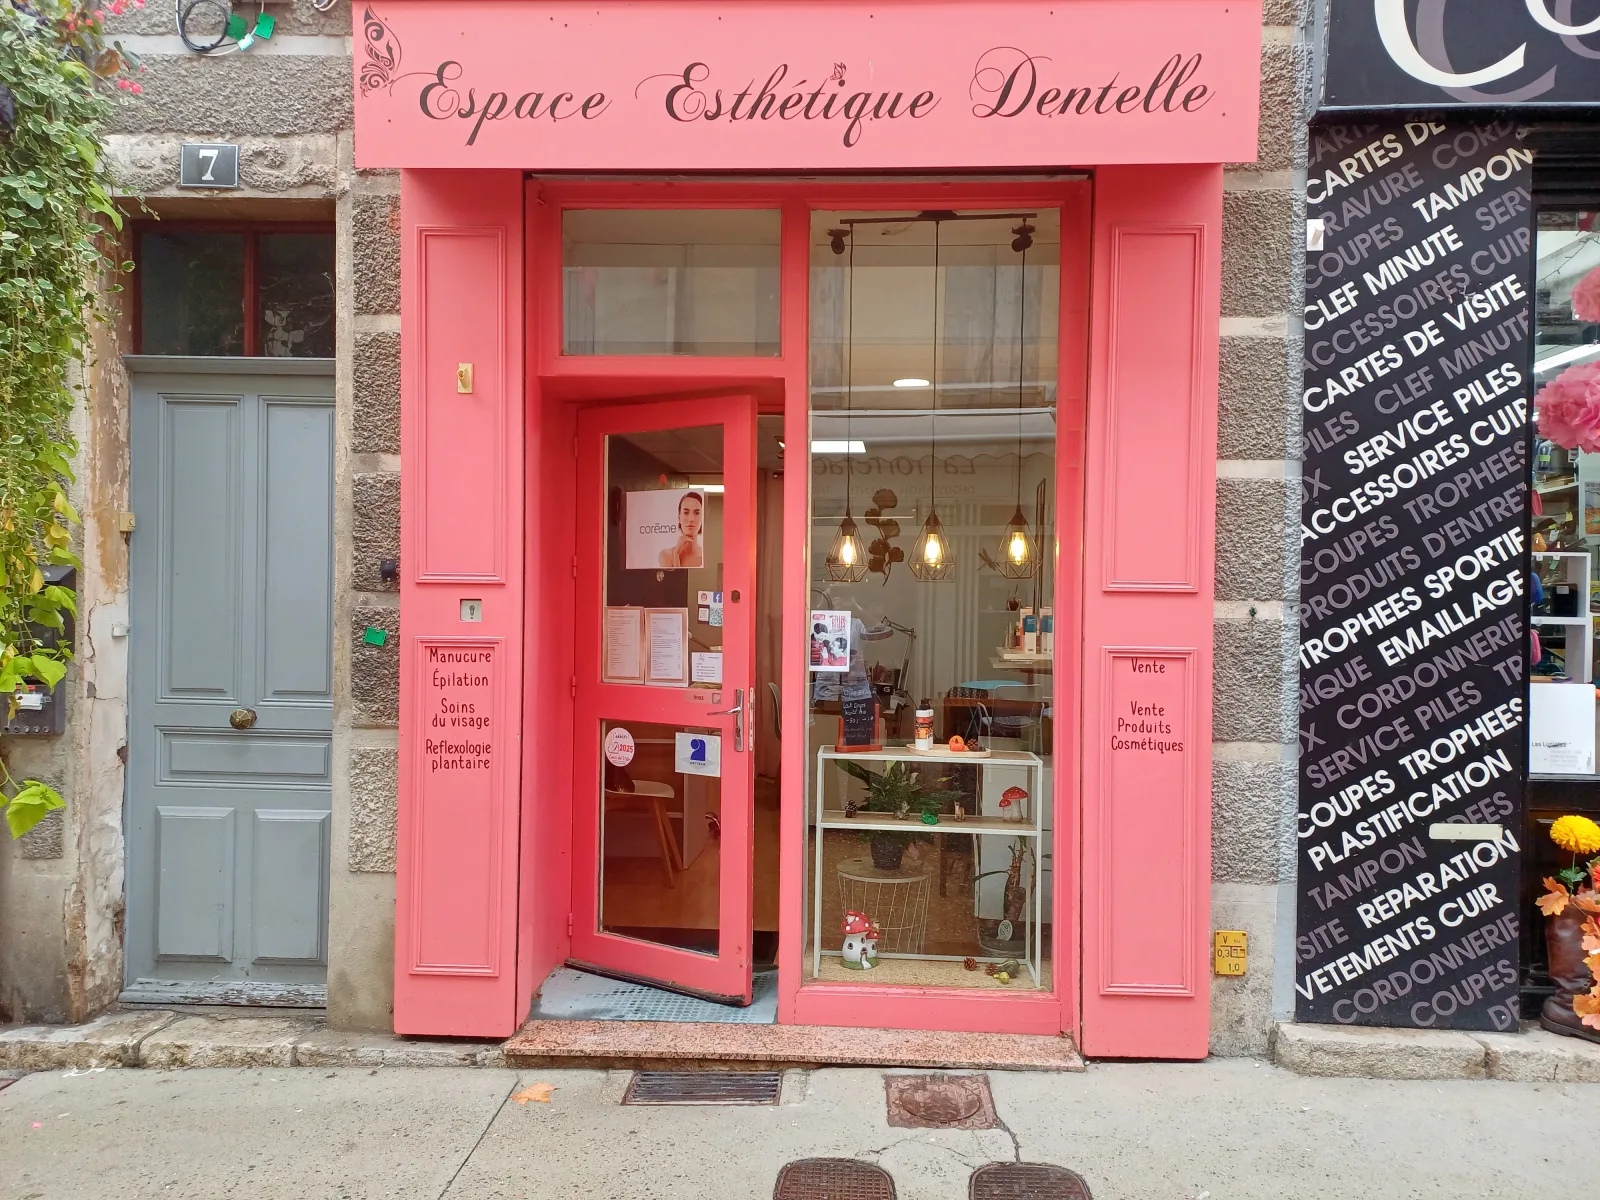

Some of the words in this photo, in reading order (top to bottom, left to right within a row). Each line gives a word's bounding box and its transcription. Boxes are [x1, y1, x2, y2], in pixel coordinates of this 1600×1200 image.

[390, 60, 612, 147] Espace
[635, 62, 941, 148] Esthétique
[970, 45, 1216, 119] Dentelle
[198, 148, 219, 182] 7
[1306, 133, 1404, 204] CARTES
[1319, 162, 1424, 237] RAVURE
[1305, 217, 1404, 289] COUPES
[1412, 147, 1534, 224] TAMPON
[1471, 226, 1530, 275] CUIR
[1303, 281, 1360, 331] CLEF
[1363, 225, 1464, 296] MINUTE
[1302, 344, 1403, 413] CARTES
[1403, 320, 1445, 357] DE
[1442, 272, 1527, 331] VISITE
[1343, 399, 1454, 475] SERVICE
[1452, 362, 1522, 414] PILES
[1374, 366, 1435, 414] CLEF
[1300, 434, 1470, 548] ACCESSOIRES
[1470, 397, 1527, 446] CUIR
[1300, 546, 1421, 629] PRODUITS
[1301, 515, 1400, 585] COUPES
[1299, 586, 1423, 670] TROPHEES
[1423, 526, 1525, 599] SPORTIF
[429, 647, 492, 663] Manucure
[432, 668, 489, 690] Épilation
[1131, 658, 1166, 674] Vente
[1299, 655, 1373, 714] RIQUE
[1377, 569, 1524, 667] EMAILLAGE
[1336, 613, 1523, 730] CORDONNERIE
[431, 715, 446, 727] du
[450, 715, 490, 730] visage
[441, 697, 475, 714] Soins
[1117, 717, 1172, 734] Produits
[1130, 700, 1165, 717] Vente
[1306, 716, 1415, 789] SERVICE
[1413, 680, 1482, 731] PILES
[425, 738, 492, 756] Reflexologie
[432, 755, 490, 773] plantaire
[1111, 735, 1184, 755] Cosmétiques
[1298, 769, 1396, 839] COUPES
[1398, 697, 1523, 780] TROPHEES
[1307, 748, 1513, 872] PLASTIFICATION
[1307, 835, 1428, 912] TAMPON
[1356, 829, 1521, 929] REPARATION
[1296, 916, 1436, 1001] VETEMENTS
[1438, 882, 1504, 927] CUIR
[1332, 912, 1520, 1024] CORDONNERIE
[1410, 959, 1518, 1027] COUPES
